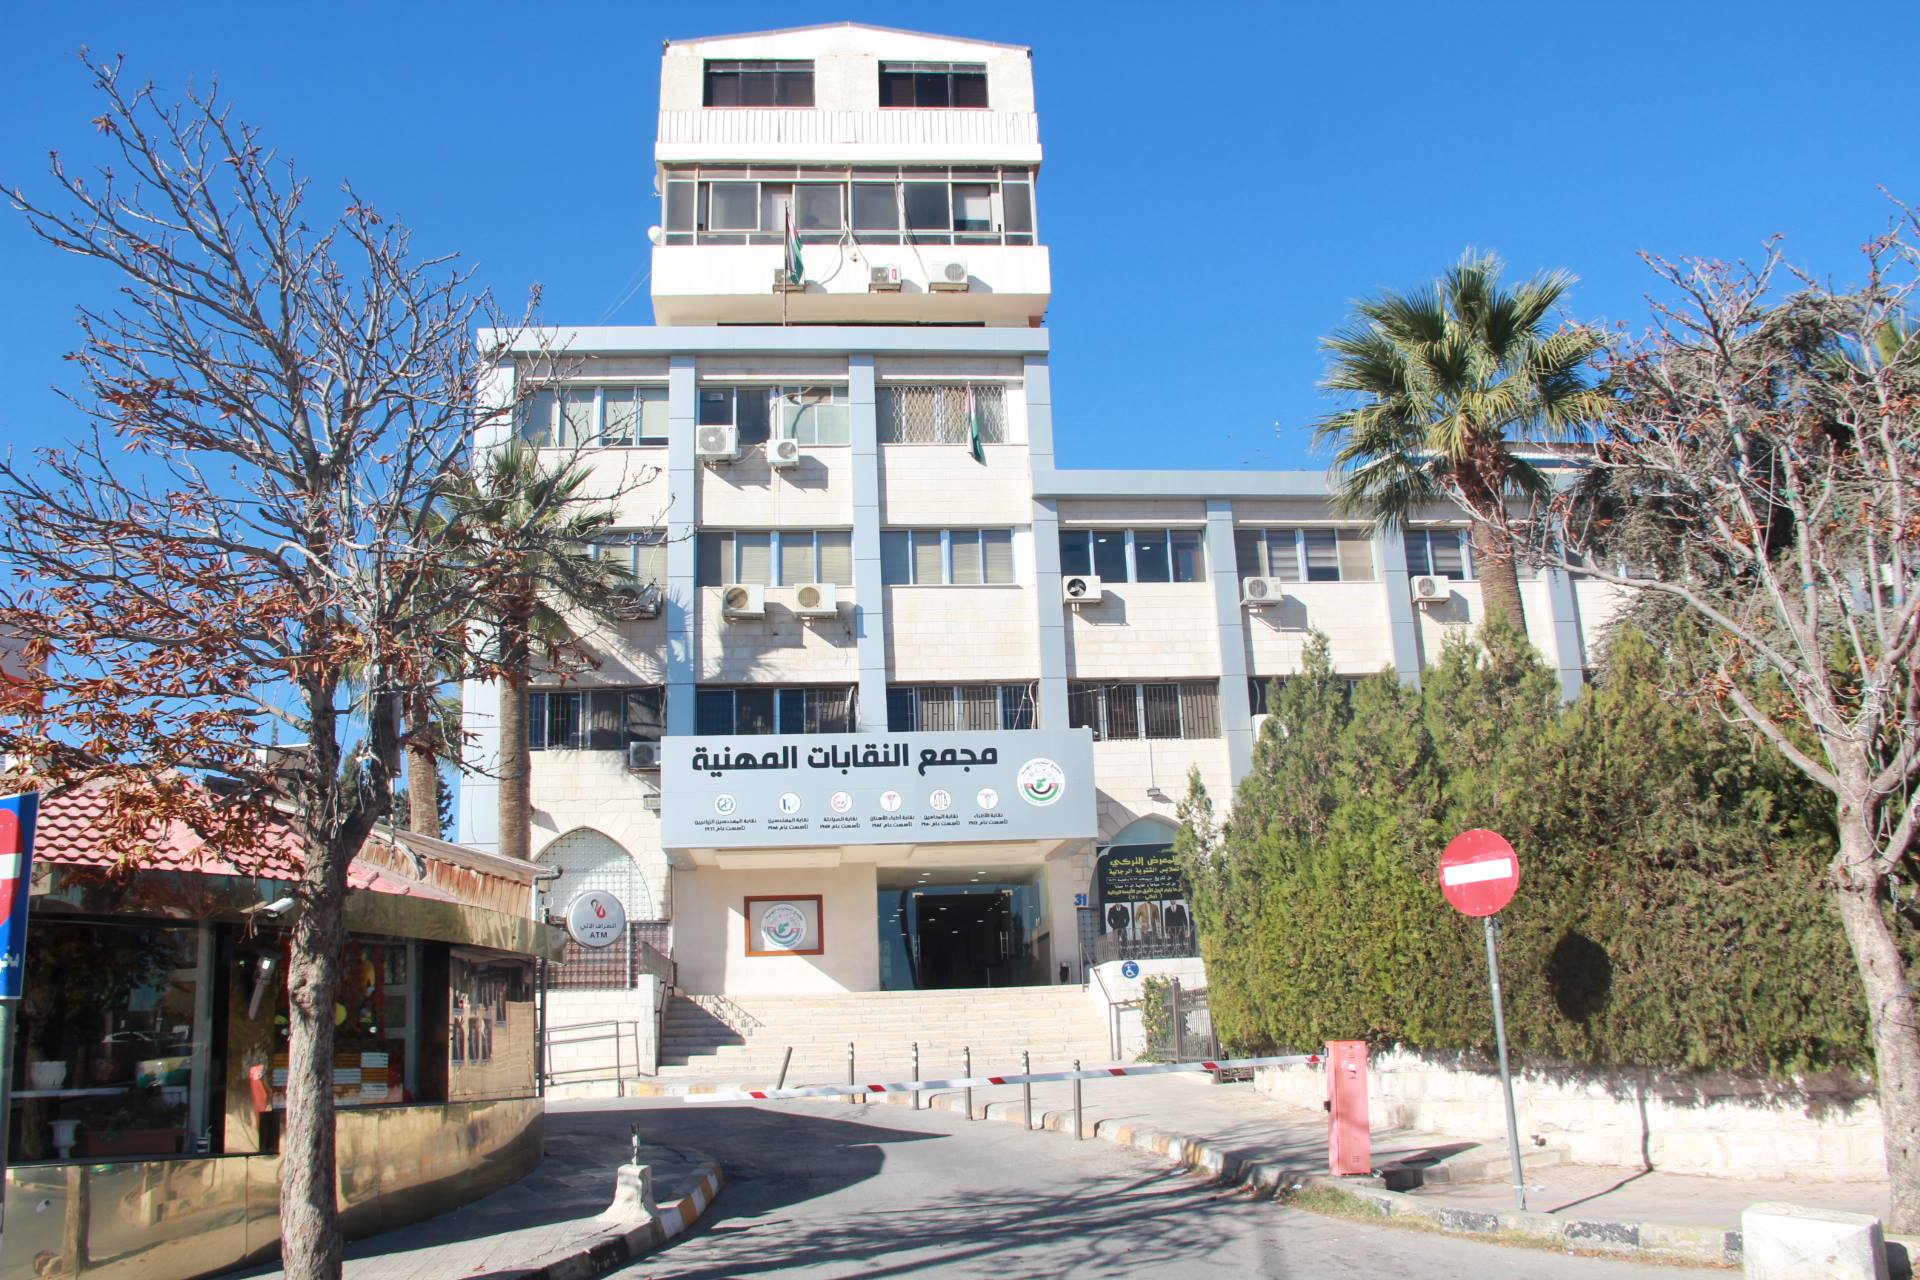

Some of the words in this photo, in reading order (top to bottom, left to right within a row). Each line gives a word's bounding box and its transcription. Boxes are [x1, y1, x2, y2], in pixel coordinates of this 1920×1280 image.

[692, 746, 798, 777] المهنية
[808, 743, 909, 775] النقابات
[917, 747, 998, 776] مجمع
[1110, 856, 1143, 867] التركي
[1073, 893, 1087, 906] 31
[595, 922, 616, 930] الصراف
